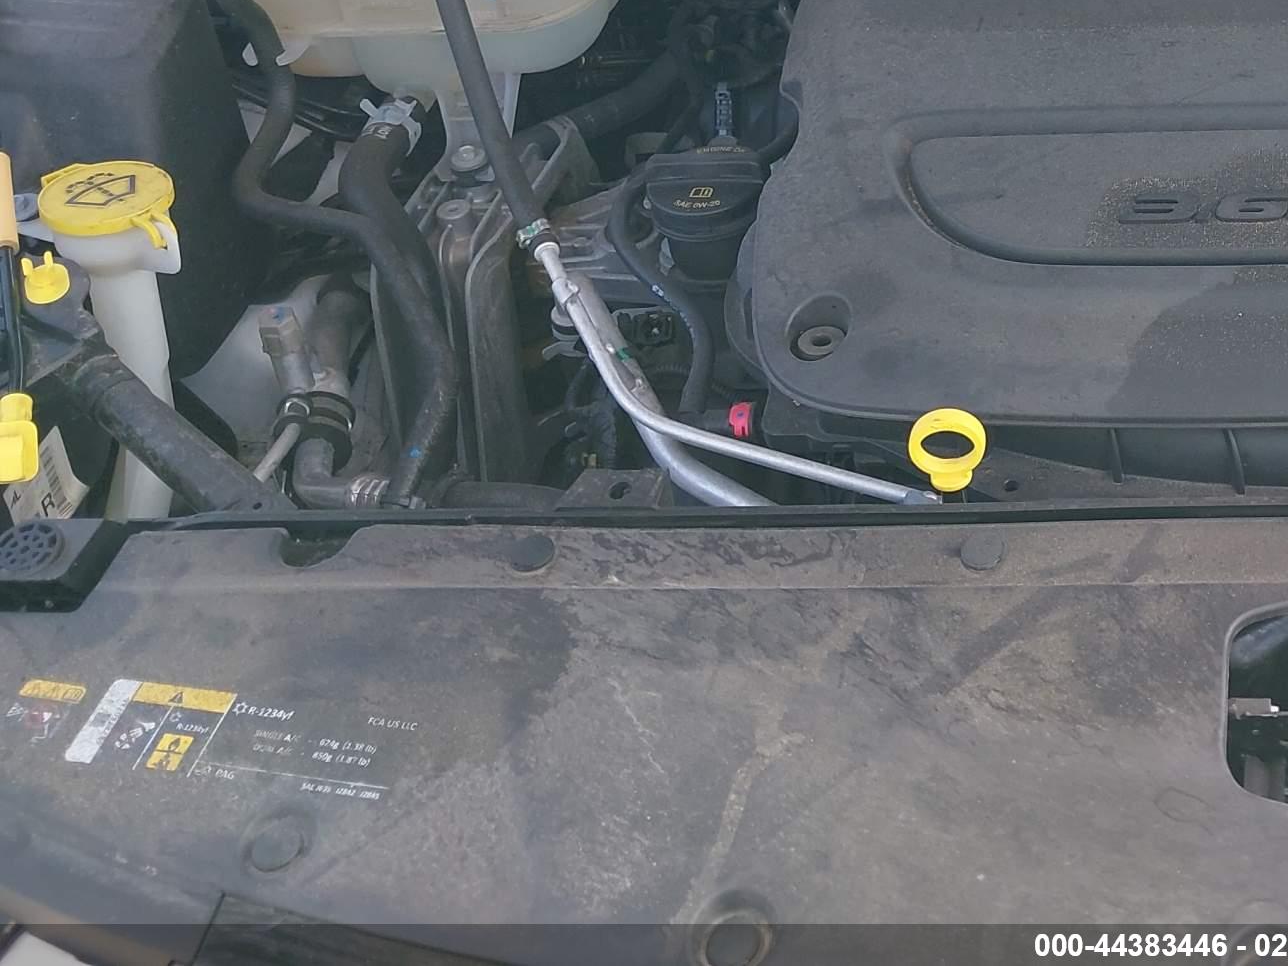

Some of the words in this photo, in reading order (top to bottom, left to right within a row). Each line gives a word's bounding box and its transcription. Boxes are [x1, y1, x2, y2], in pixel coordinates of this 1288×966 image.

[673, 199, 692, 210] SAE
[692, 200, 721, 210] 0W-20
[247, 706, 296, 722] R-1234yf
[367, 716, 385, 727] FCA
[386, 719, 400, 729] US
[401, 721, 419, 731] LLC
